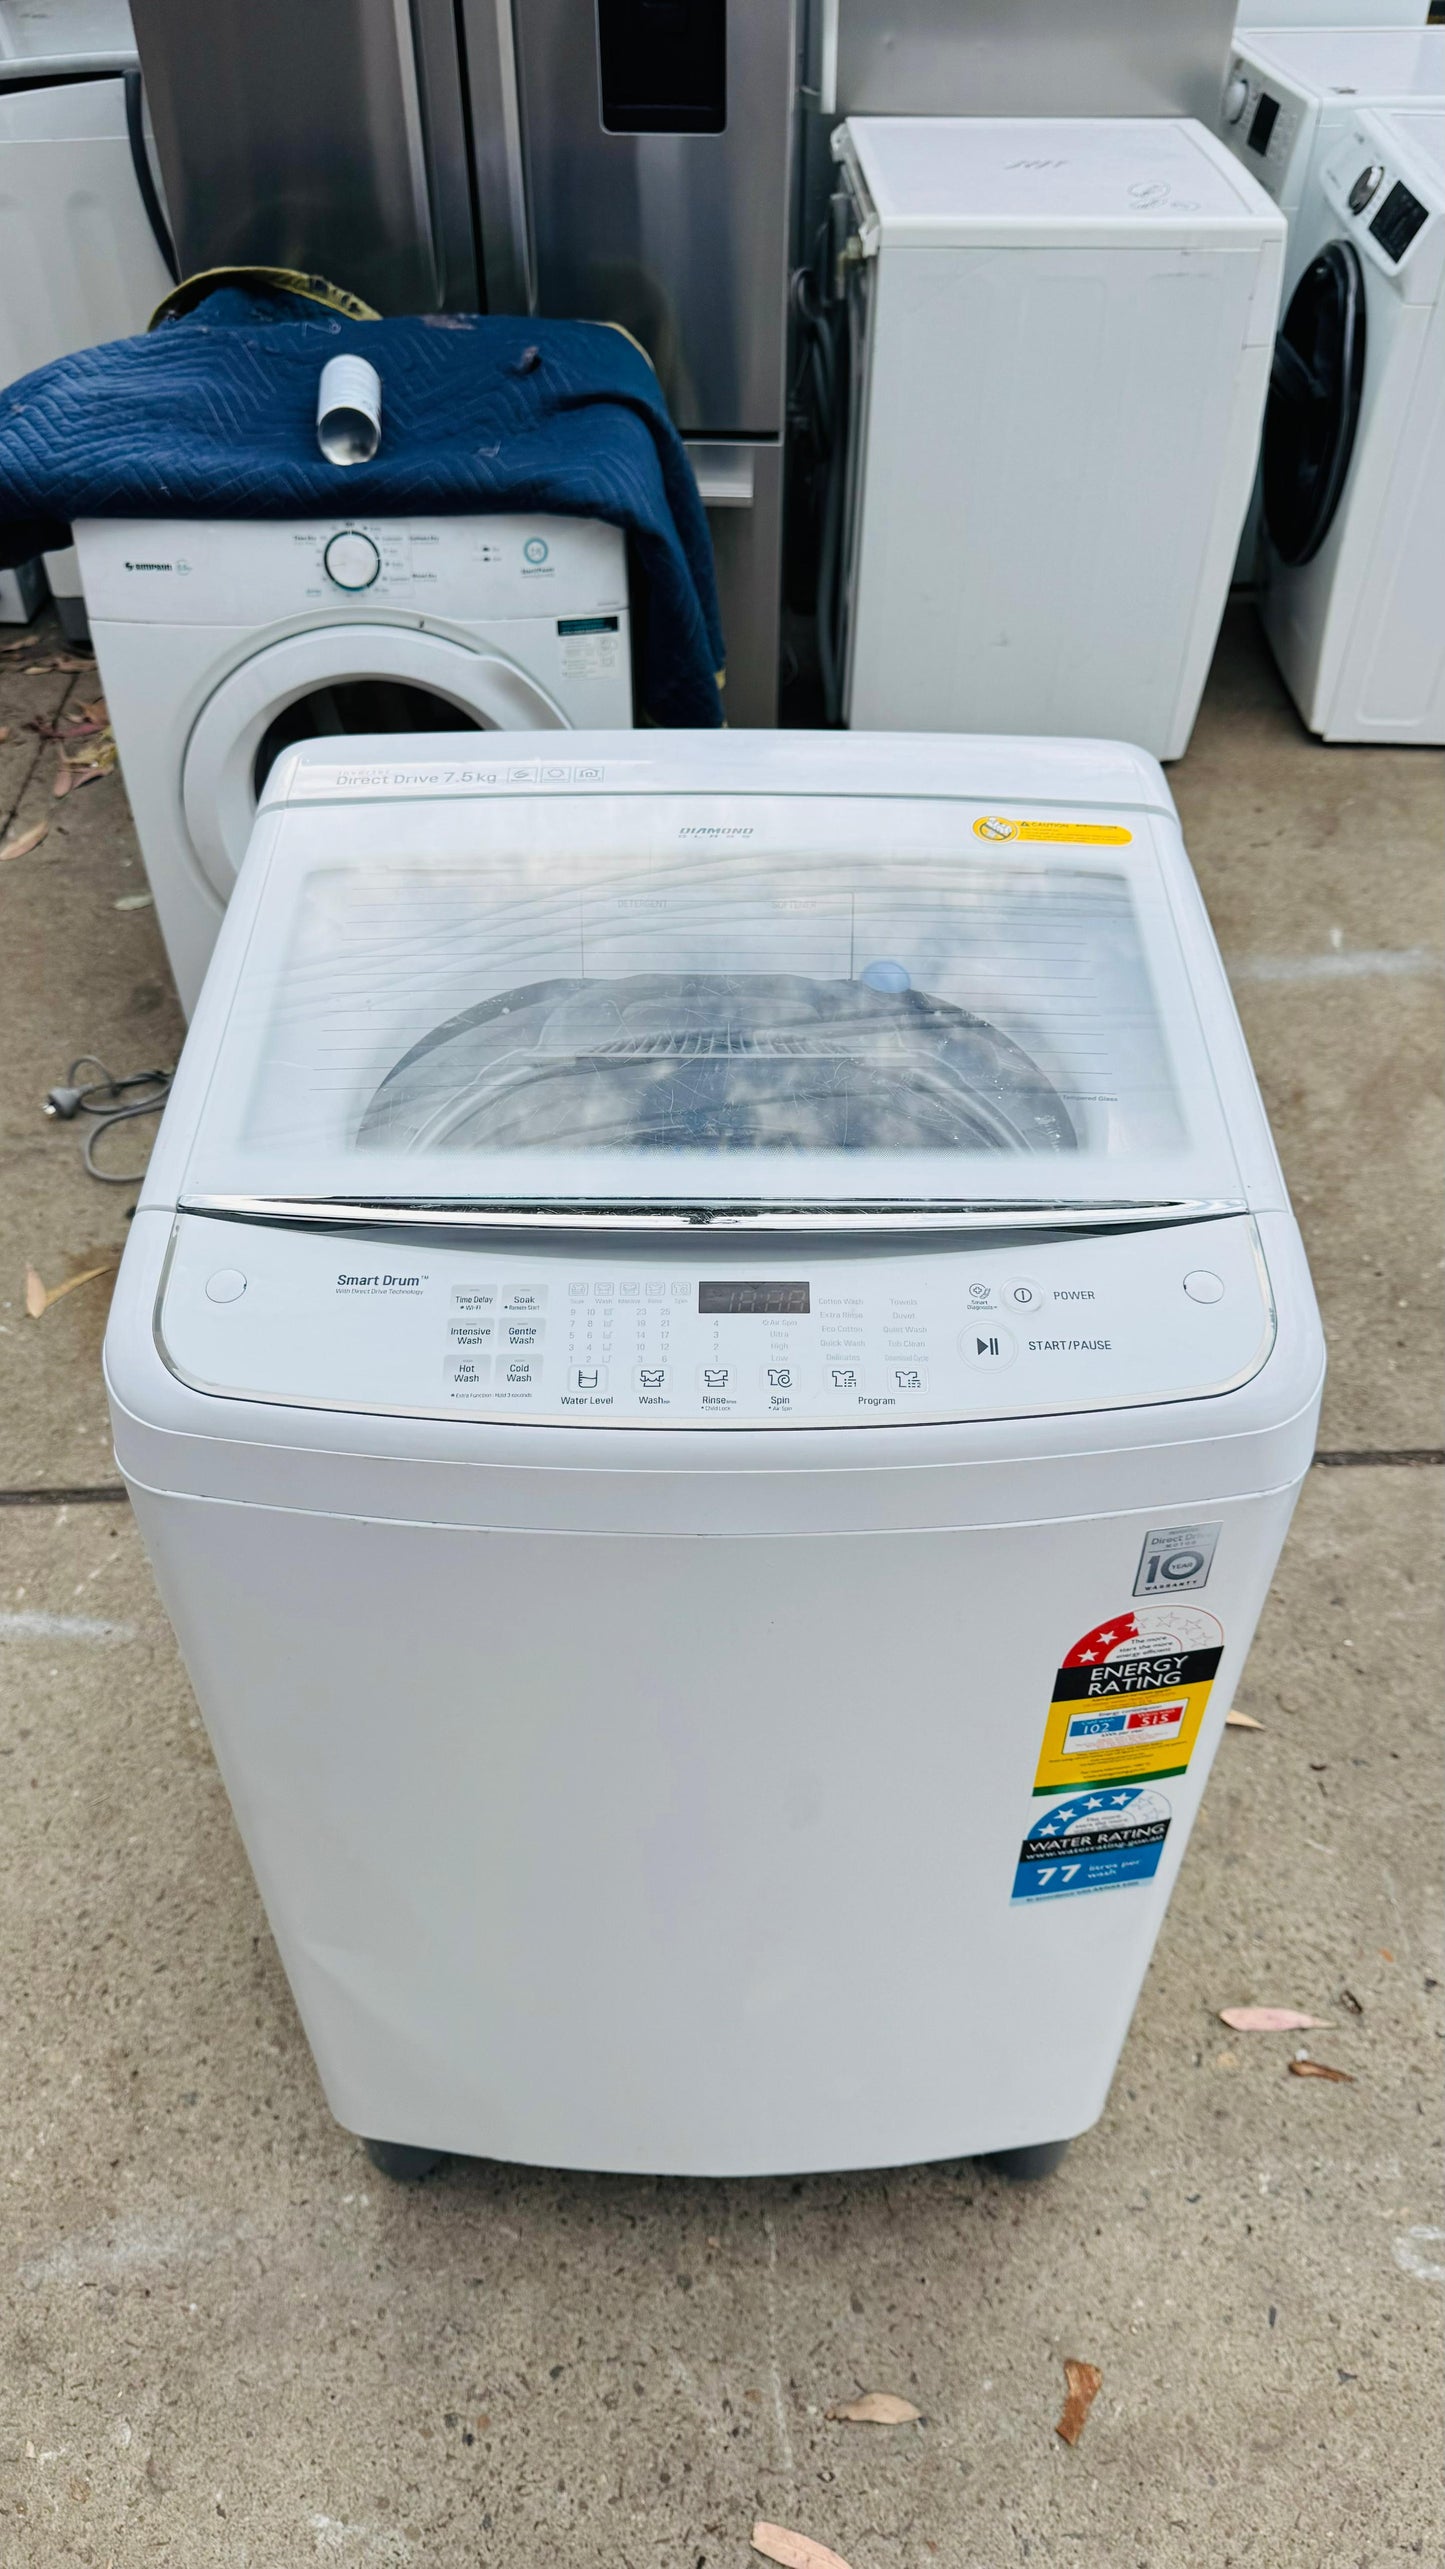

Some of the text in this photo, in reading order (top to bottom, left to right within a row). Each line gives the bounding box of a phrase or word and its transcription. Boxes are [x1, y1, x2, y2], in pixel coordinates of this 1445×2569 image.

[336, 775, 389, 785] Direct
[394, 772, 439, 784] Drive
[1031, 821, 1070, 829] CAUTION
[337, 1274, 380, 1286] Smart
[388, 1288, 424, 1296] Technology
[1053, 1290, 1096, 1301] POWER
[455, 1295, 494, 1305] Time Delay
[513, 1295, 536, 1304] Soak
[889, 1298, 918, 1306] Towels
[570, 1308, 596, 1316] 9 10
[636, 1308, 671, 1316] 23 25
[819, 1311, 864, 1319] Extra Rinse
[892, 1311, 915, 1319] Duvet
[570, 1320, 593, 1328] 7 8
[636, 1319, 671, 1327] 19 21
[450, 1327, 492, 1336] Intensive
[508, 1327, 537, 1336] Gentle
[821, 1325, 863, 1333] Eco Cotton
[882, 1326, 903, 1334] Quiet
[713, 1331, 720, 1339] 3
[457, 1336, 483, 1345] Wash
[509, 1336, 535, 1345] Wash
[819, 1339, 866, 1347] Quick Wash
[636, 1343, 670, 1351] 10 12
[713, 1343, 720, 1351] 2
[770, 1342, 789, 1351] High
[1028, 1340, 1113, 1351] START/PAUSE
[569, 1355, 592, 1363] 1 2
[637, 1355, 668, 1363] 3 6
[771, 1354, 789, 1362] Low
[458, 1364, 475, 1373] Hot
[509, 1363, 530, 1373] Cold
[453, 1373, 480, 1383] Wash
[506, 1373, 532, 1383] Wash
[560, 1395, 614, 1405] Water Level
[638, 1395, 664, 1404] Wash
[702, 1395, 727, 1404] Rinse
[770, 1395, 790, 1406] Spin
[857, 1396, 896, 1407] Program
[1151, 1534, 1184, 1546] Direct
[1145, 1550, 1205, 1584] 10
[1171, 1561, 1194, 1570] YEAR
[1144, 1580, 1198, 1591] WARRANTY
[1090, 1655, 1189, 1681] ENERGY
[1088, 1671, 1182, 1696] RATING
[1098, 1710, 1120, 1718] Energy
[1083, 1722, 1111, 1734] 102
[1029, 1835, 1093, 1853] WATER
[1097, 1823, 1167, 1843] RATING
[1120, 1859, 1141, 1869] per
[1036, 1863, 1082, 1886] 77
[1087, 1869, 1118, 1879] wash
